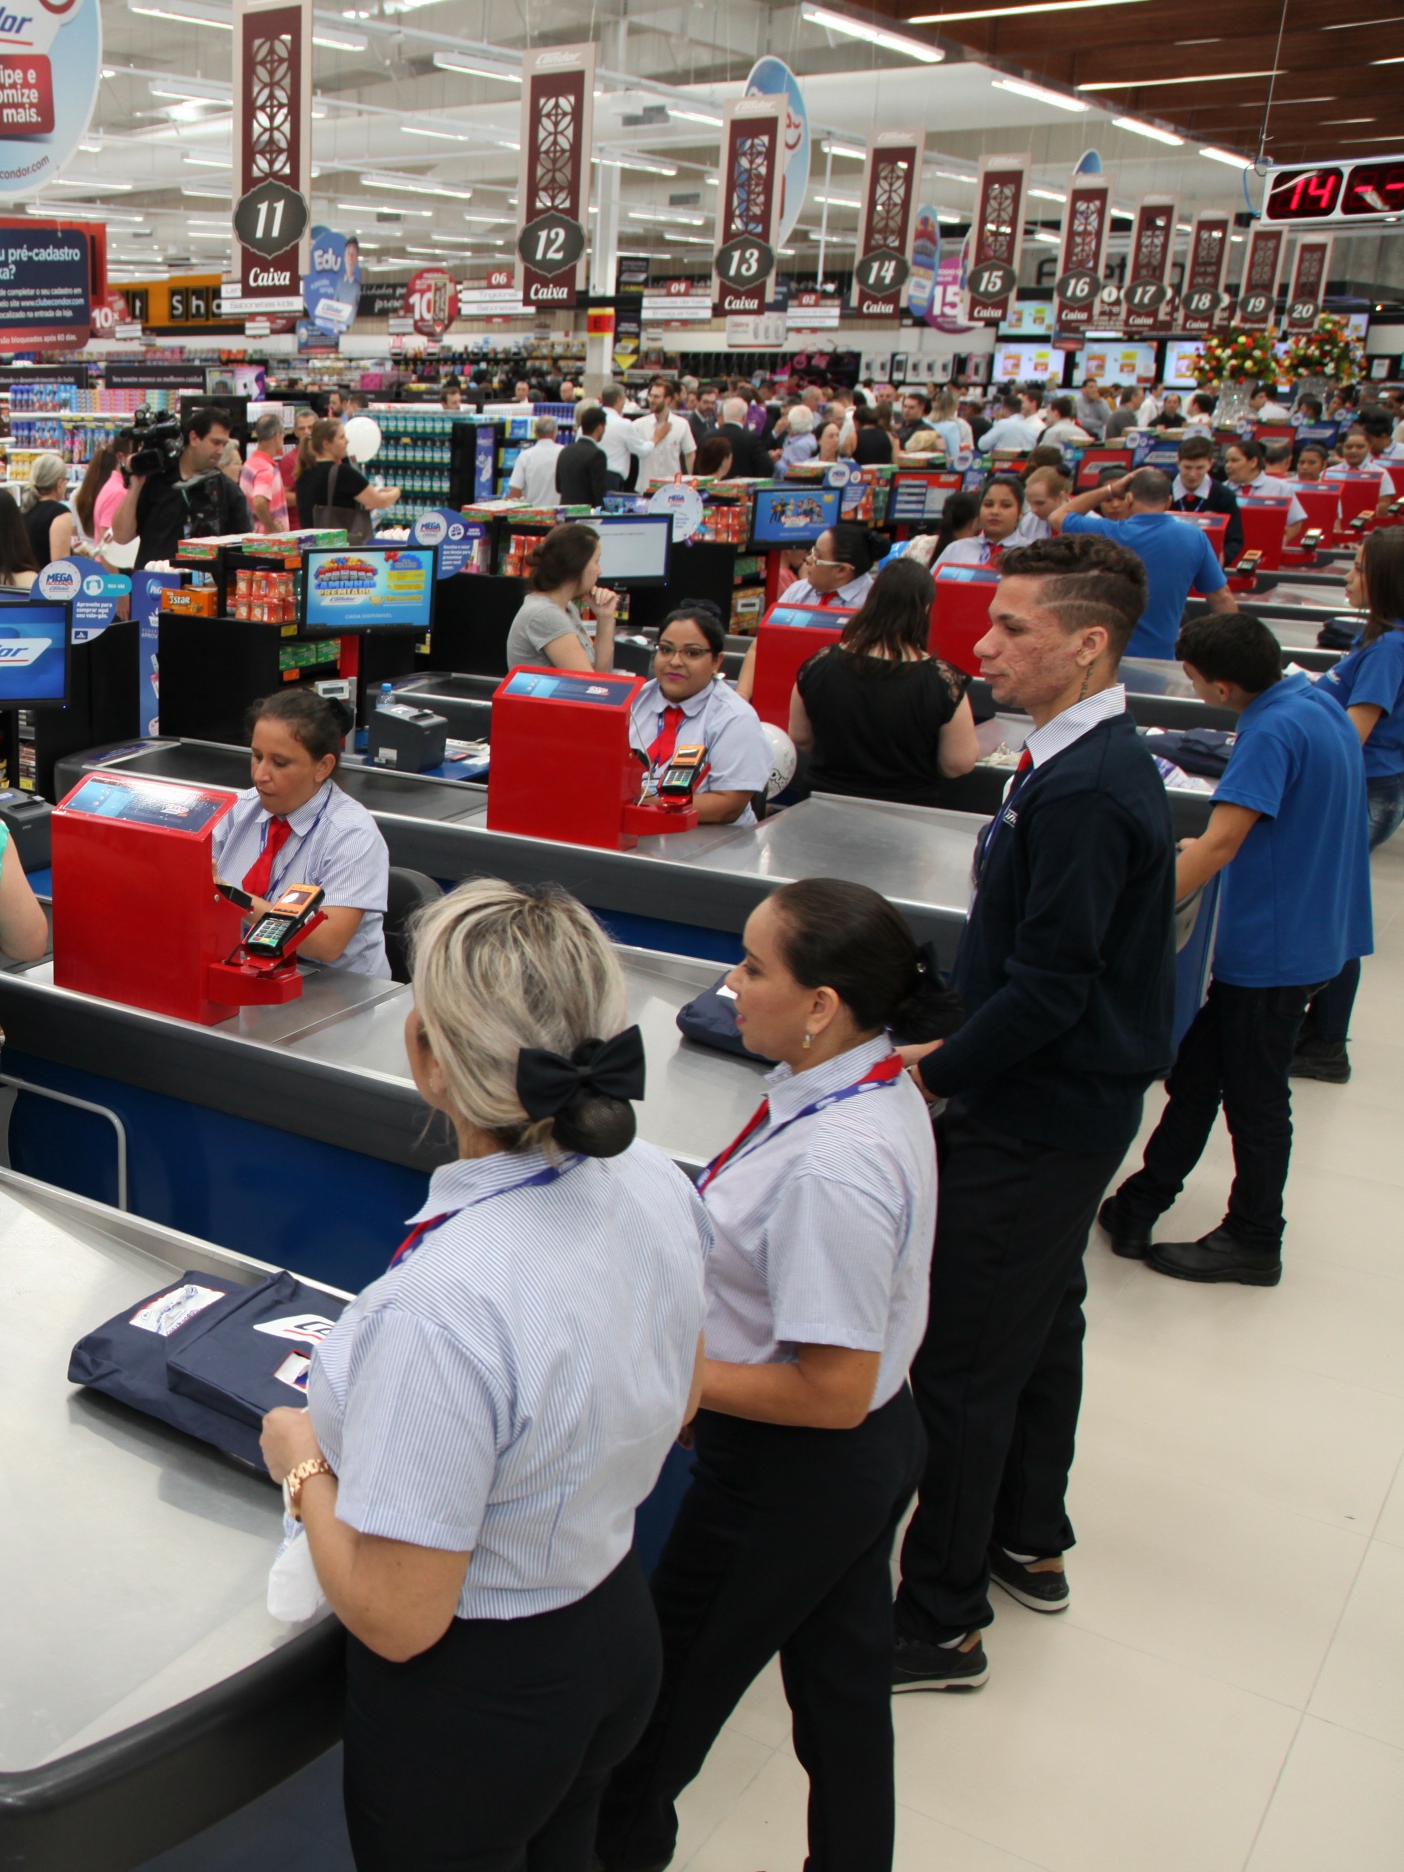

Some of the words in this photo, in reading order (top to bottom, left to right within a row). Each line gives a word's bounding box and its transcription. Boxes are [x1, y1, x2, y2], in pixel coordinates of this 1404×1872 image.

[27, 70, 37, 83] e
[3, 104, 42, 123] mais.
[255, 199, 285, 238] 11
[535, 227, 566, 260] 12
[8, 244, 80, 264] pré-cadastro
[314, 247, 341, 271] Edu
[729, 248, 759, 276] 13
[249, 267, 290, 287] Caixa
[491, 273, 507, 285] 06
[867, 260, 896, 284] 14
[979, 270, 1003, 292] 15
[1066, 277, 1090, 297] 16
[7, 288, 35, 297] completar
[51, 287, 72, 295] cadastro
[530, 283, 568, 300] Caixa
[1134, 285, 1157, 304] 17
[10, 299, 20, 307] site
[724, 296, 758, 310] Caixa
[863, 300, 893, 314] Caixa
[1190, 292, 1212, 310] 18
[1246, 297, 1266, 312] 19
[973, 306, 1002, 318] Caixa
[1061, 310, 1088, 320] Caixa
[1292, 304, 1314, 317] 20
[1129, 315, 1153, 324] Caixa
[1186, 320, 1209, 329] Caixa
[11, 335, 42, 344] bloqueados
[47, 573, 73, 582] MEGA
